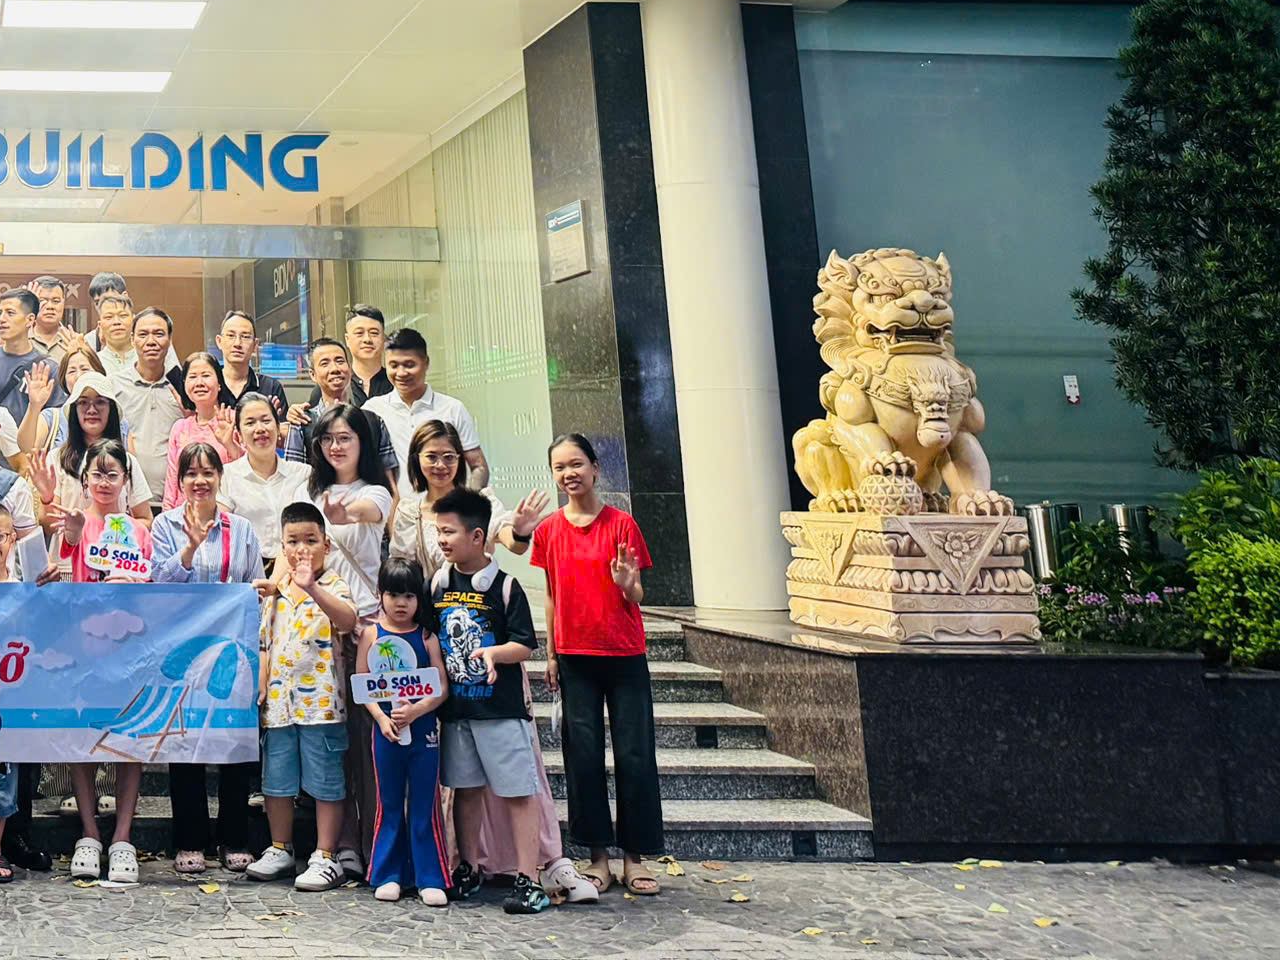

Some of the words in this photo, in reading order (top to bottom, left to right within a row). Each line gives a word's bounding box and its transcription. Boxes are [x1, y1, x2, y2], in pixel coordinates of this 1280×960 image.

[115, 558, 148, 573] 2026
[443, 592, 485, 603] SPACE
[397, 684, 433, 697] 2026
